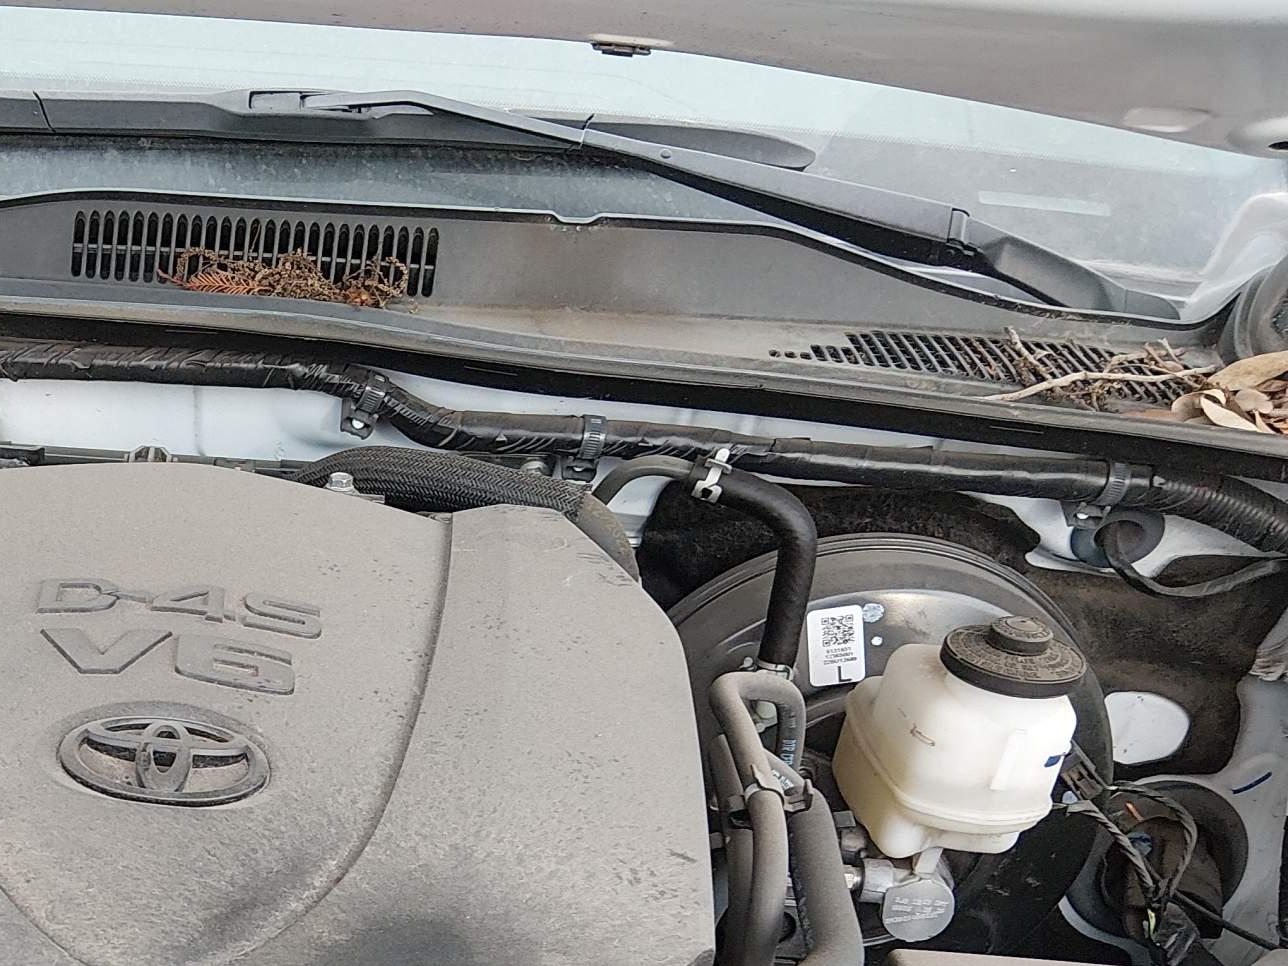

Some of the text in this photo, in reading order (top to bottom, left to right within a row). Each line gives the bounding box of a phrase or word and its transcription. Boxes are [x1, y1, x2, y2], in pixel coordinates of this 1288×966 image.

[36, 579, 322, 640] D-4S
[40, 628, 296, 695] V6
[837, 666, 852, 683] L
